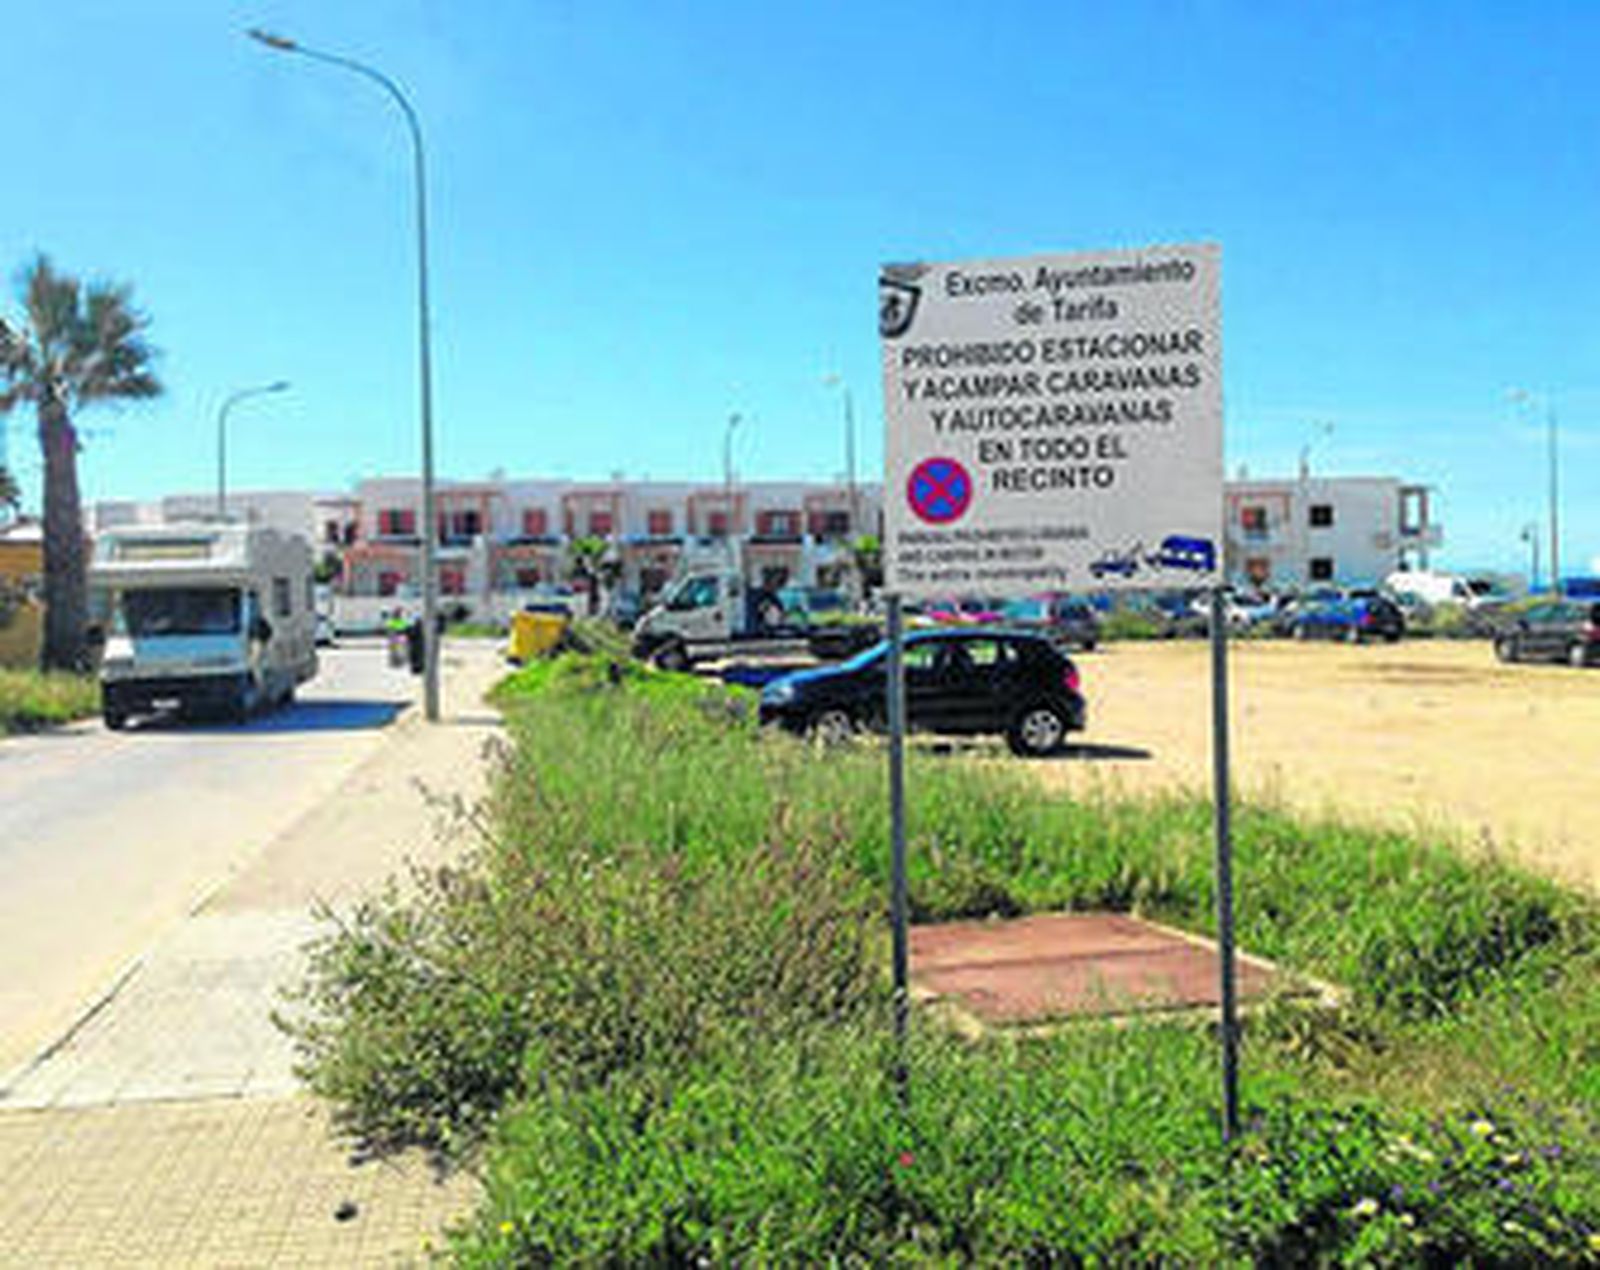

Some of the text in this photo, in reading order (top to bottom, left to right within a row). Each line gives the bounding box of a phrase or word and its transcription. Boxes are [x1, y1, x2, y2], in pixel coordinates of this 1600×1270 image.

[1034, 259, 1195, 293] Ayuntamiento
[1013, 297, 1118, 325] de Tarifa
[902, 330, 1203, 368] PROHIBIDO ESTACIONAR
[904, 363, 1201, 401] Y ACAMPAR CARAVANAS
[931, 401, 1174, 433] Y AUTOCARAVANAS
[978, 435, 1128, 463] EN TODO EL
[992, 466, 1115, 492] RECINTO
